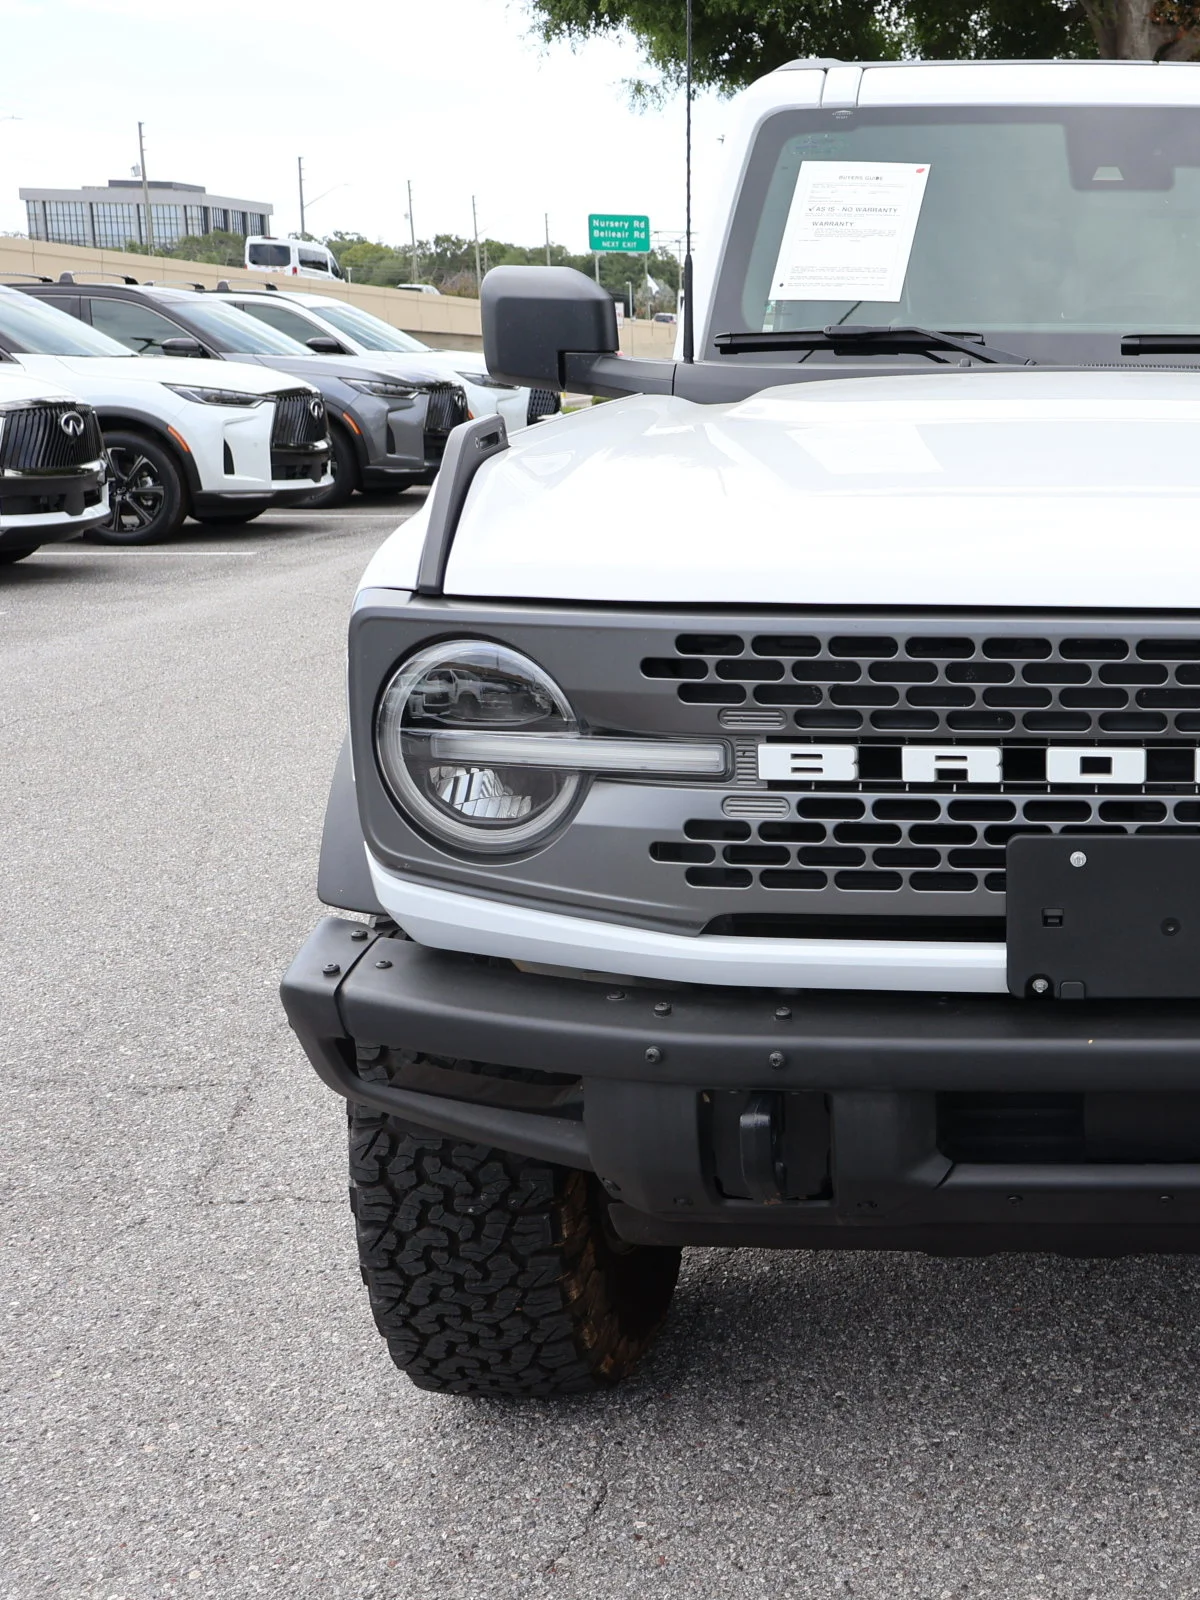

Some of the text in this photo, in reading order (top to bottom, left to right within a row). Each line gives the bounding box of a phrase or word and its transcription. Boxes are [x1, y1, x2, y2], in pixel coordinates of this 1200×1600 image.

[592, 219, 645, 230] Nursery Rd
[593, 229, 645, 239] Belleair Rd
